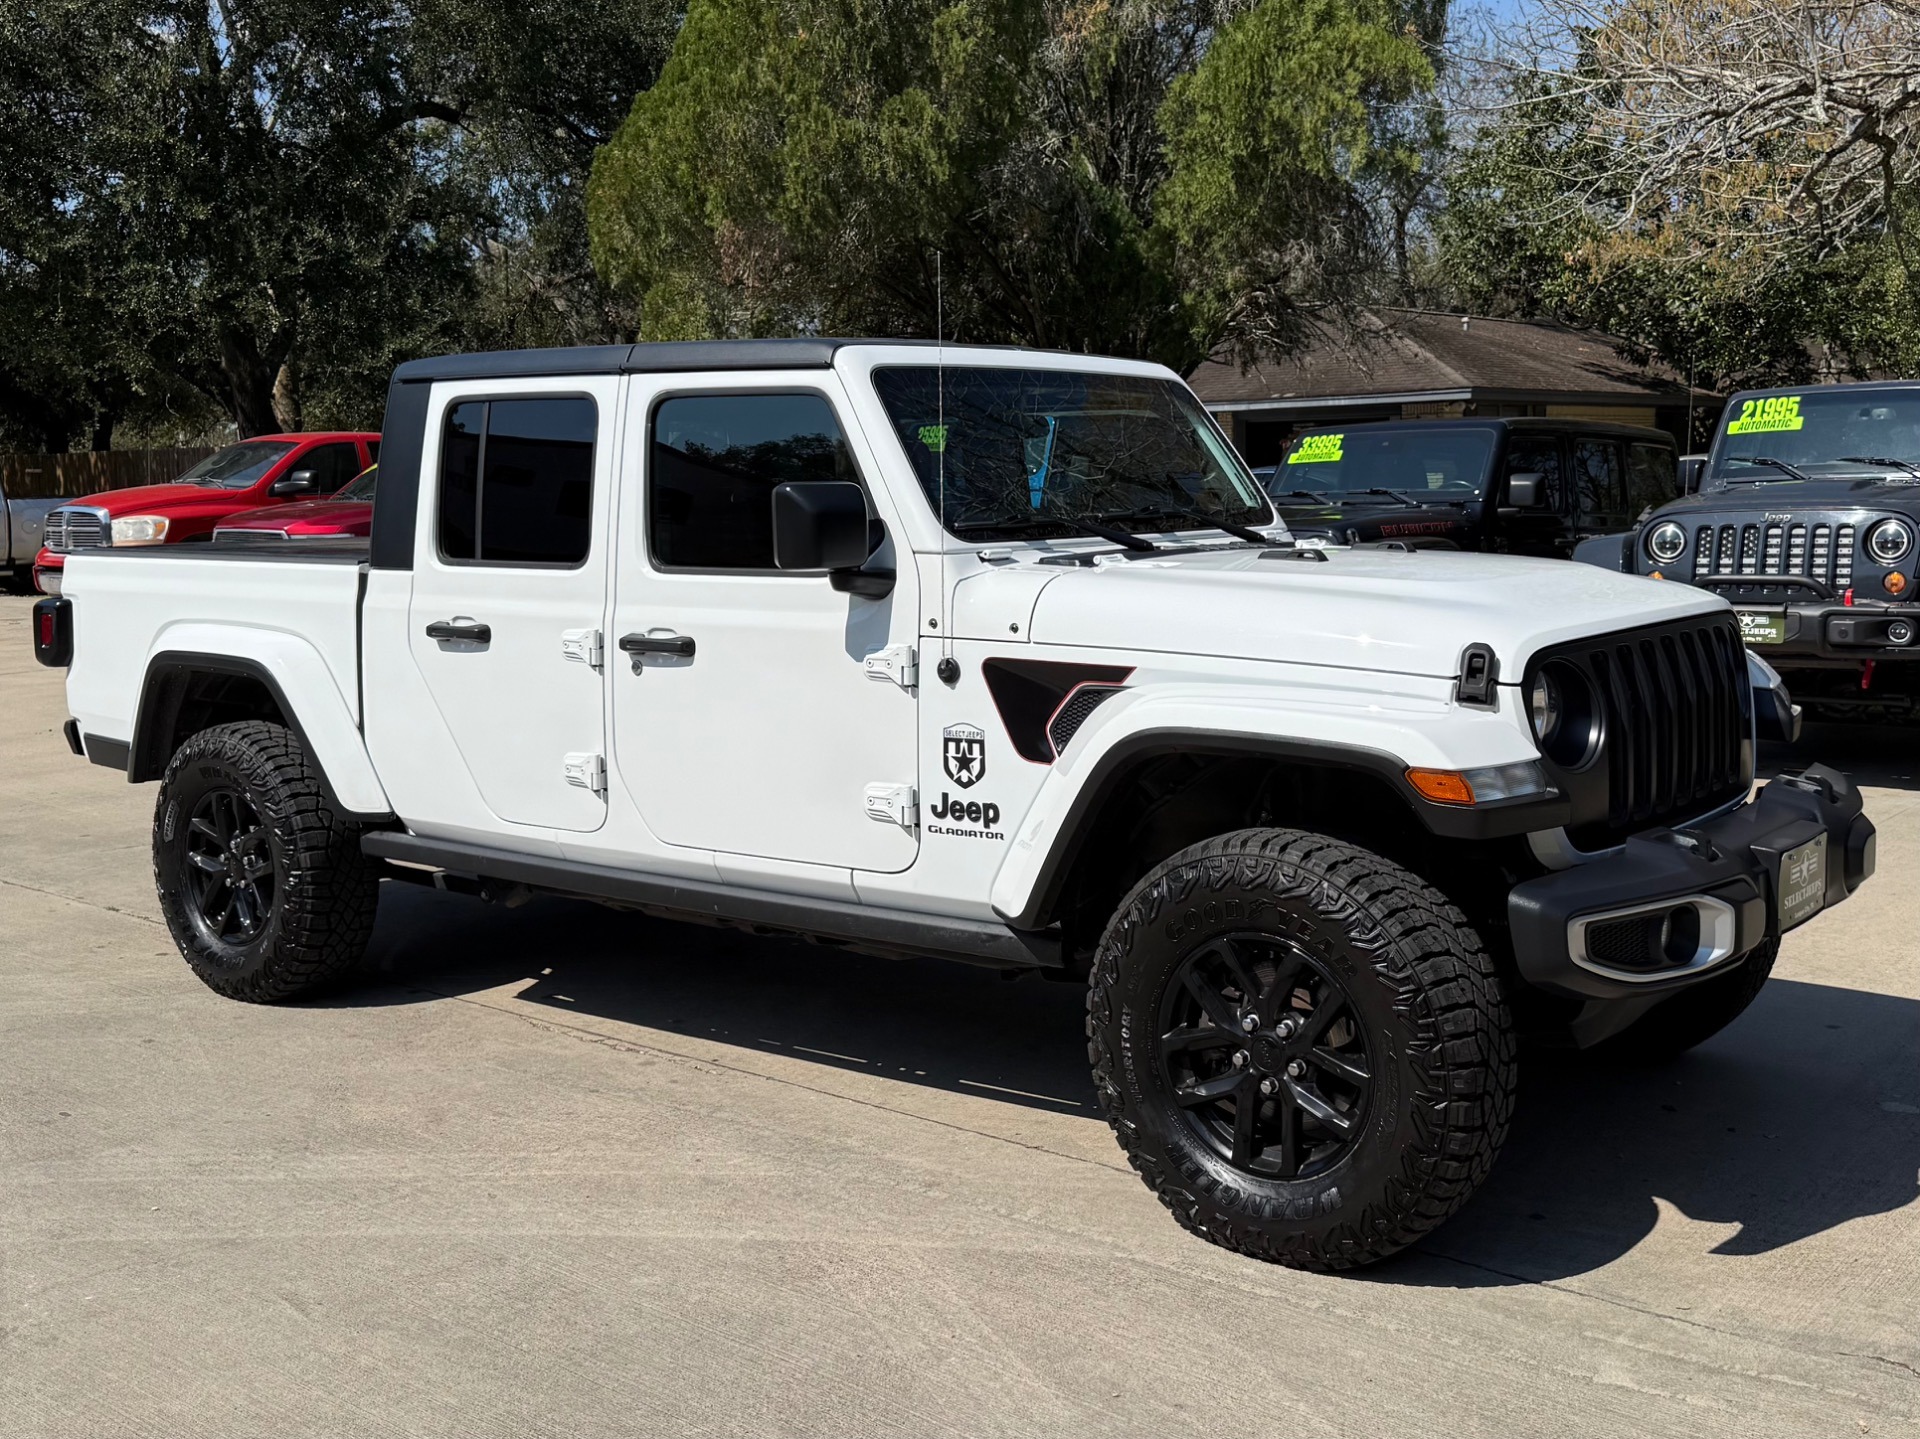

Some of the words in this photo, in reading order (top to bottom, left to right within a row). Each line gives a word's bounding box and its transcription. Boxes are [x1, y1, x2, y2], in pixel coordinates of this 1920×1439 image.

[1740, 396, 1801, 421] 21995
[1737, 418, 1793, 432] AUTOMATIC
[1299, 434, 1344, 453] 33995
[1760, 512, 1792, 525] Jeep
[1380, 521, 1454, 537] RUBICON
[945, 729, 983, 739] SELECTJEEPS
[930, 792, 1001, 829] Jeep
[927, 824, 1005, 841] GLADIATOR
[1783, 880, 1822, 910] SELECTJEEPS
